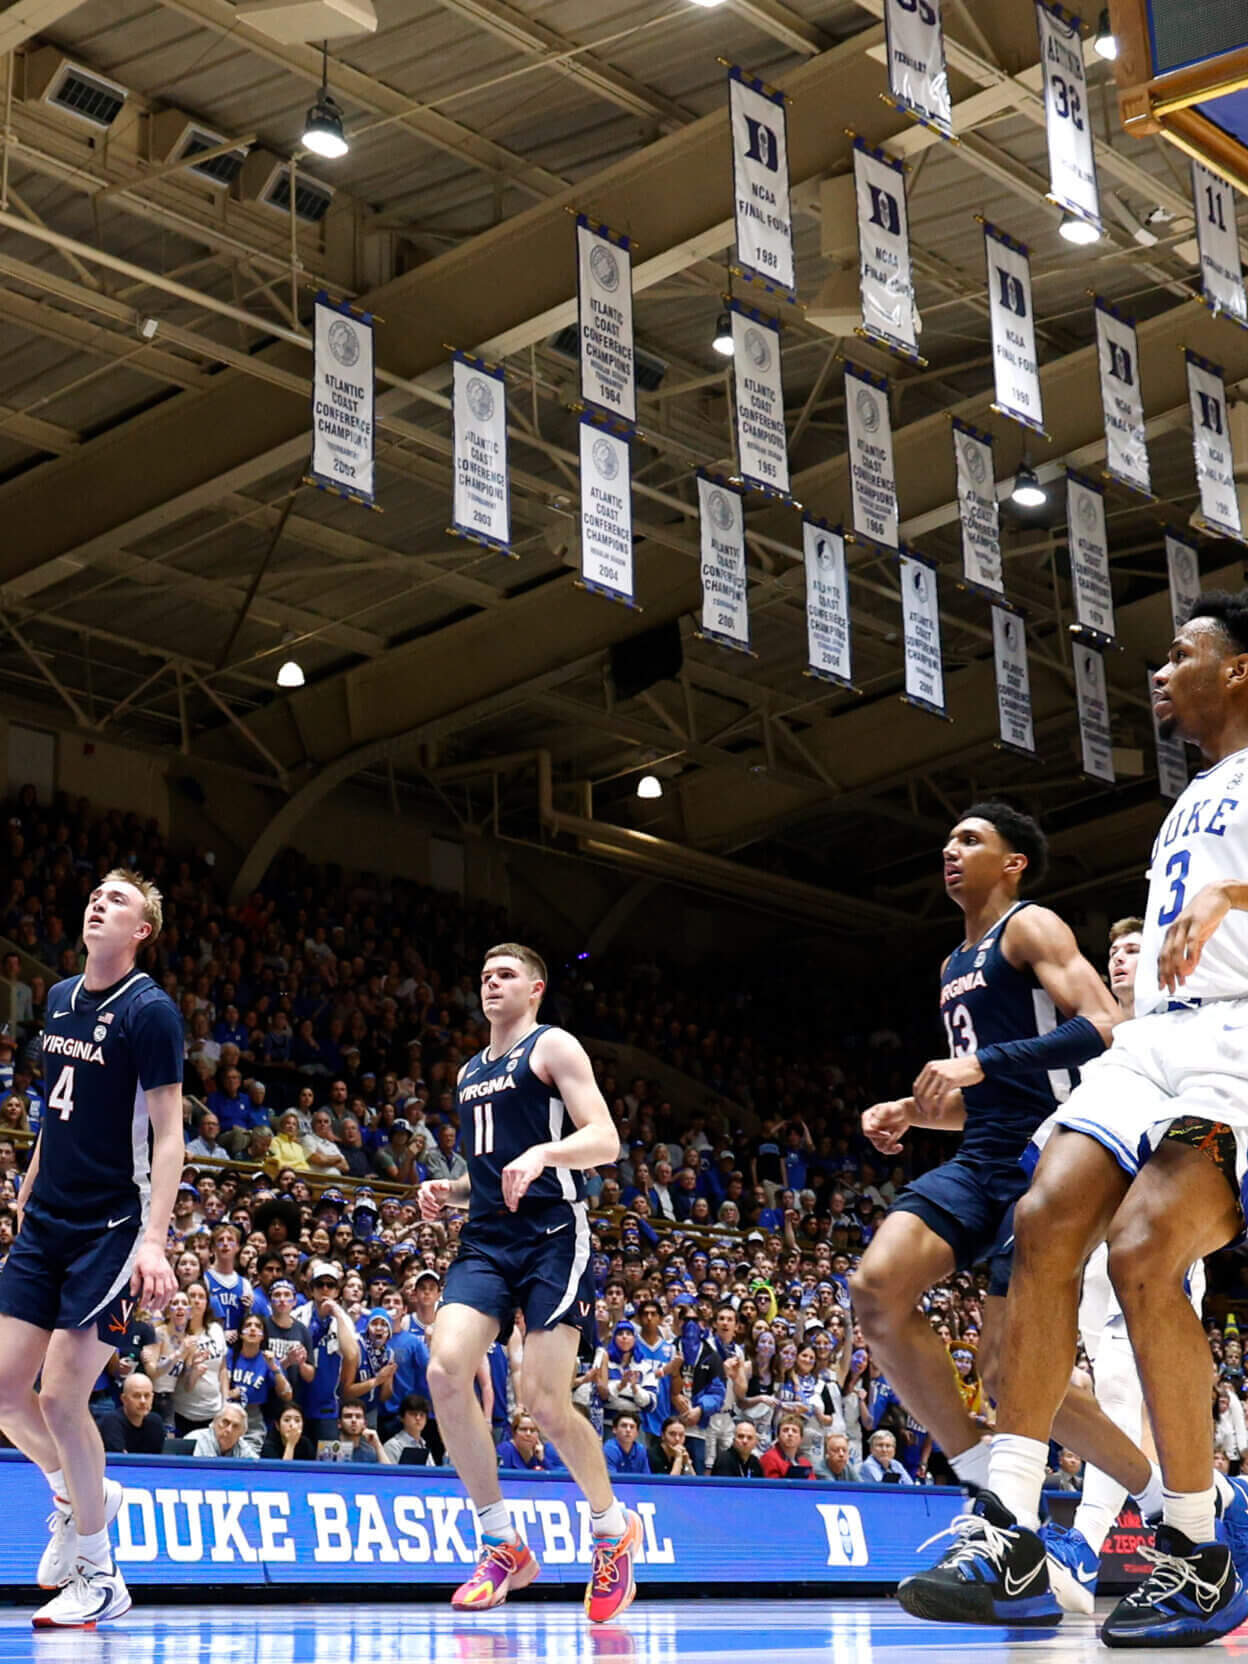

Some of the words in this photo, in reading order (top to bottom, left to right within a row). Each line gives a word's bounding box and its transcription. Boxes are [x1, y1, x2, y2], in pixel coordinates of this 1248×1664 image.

[1052, 75, 1084, 132] 32
[751, 183, 777, 206] NCAA
[1205, 185, 1227, 233] 11
[738, 200, 766, 225] FINAL
[875, 247, 899, 267] NCAA
[590, 295, 624, 327] ATLANTIC
[594, 315, 620, 338] COAST
[1005, 328, 1027, 349] NCAA
[583, 325, 632, 361] CONFERENCE
[586, 342, 631, 377] CHAMPIONS
[325, 373, 365, 400] ATLANTIC
[744, 377, 776, 403] ATLANTIC
[331, 391, 359, 413] COAST
[751, 394, 772, 416] COAST
[315, 401, 371, 435] CONFERENCE
[738, 404, 785, 436] CONFERENCE
[464, 430, 499, 455] ATLANTIC
[742, 421, 785, 450] CHAMPIONS
[470, 447, 493, 467] COAST
[457, 457, 505, 488] CONFERENCE
[458, 473, 504, 501] CHAMPIONS
[590, 485, 623, 510] ATLANTIC
[583, 512, 630, 542] CONFERENCE
[596, 503, 619, 522] COAST
[586, 527, 629, 555] CHAMPIONS
[1158, 849, 1192, 927] 3
[943, 1003, 979, 1059] 13
[41, 1032, 105, 1065] VIRGINIA
[48, 1064, 75, 1122] 4
[458, 1073, 517, 1105] VIRGINIA
[472, 1102, 494, 1157] 11
[227, 1367, 265, 1390] UKE
[115, 1488, 297, 1563] DUKE
[307, 1493, 676, 1564] BASKTBL
